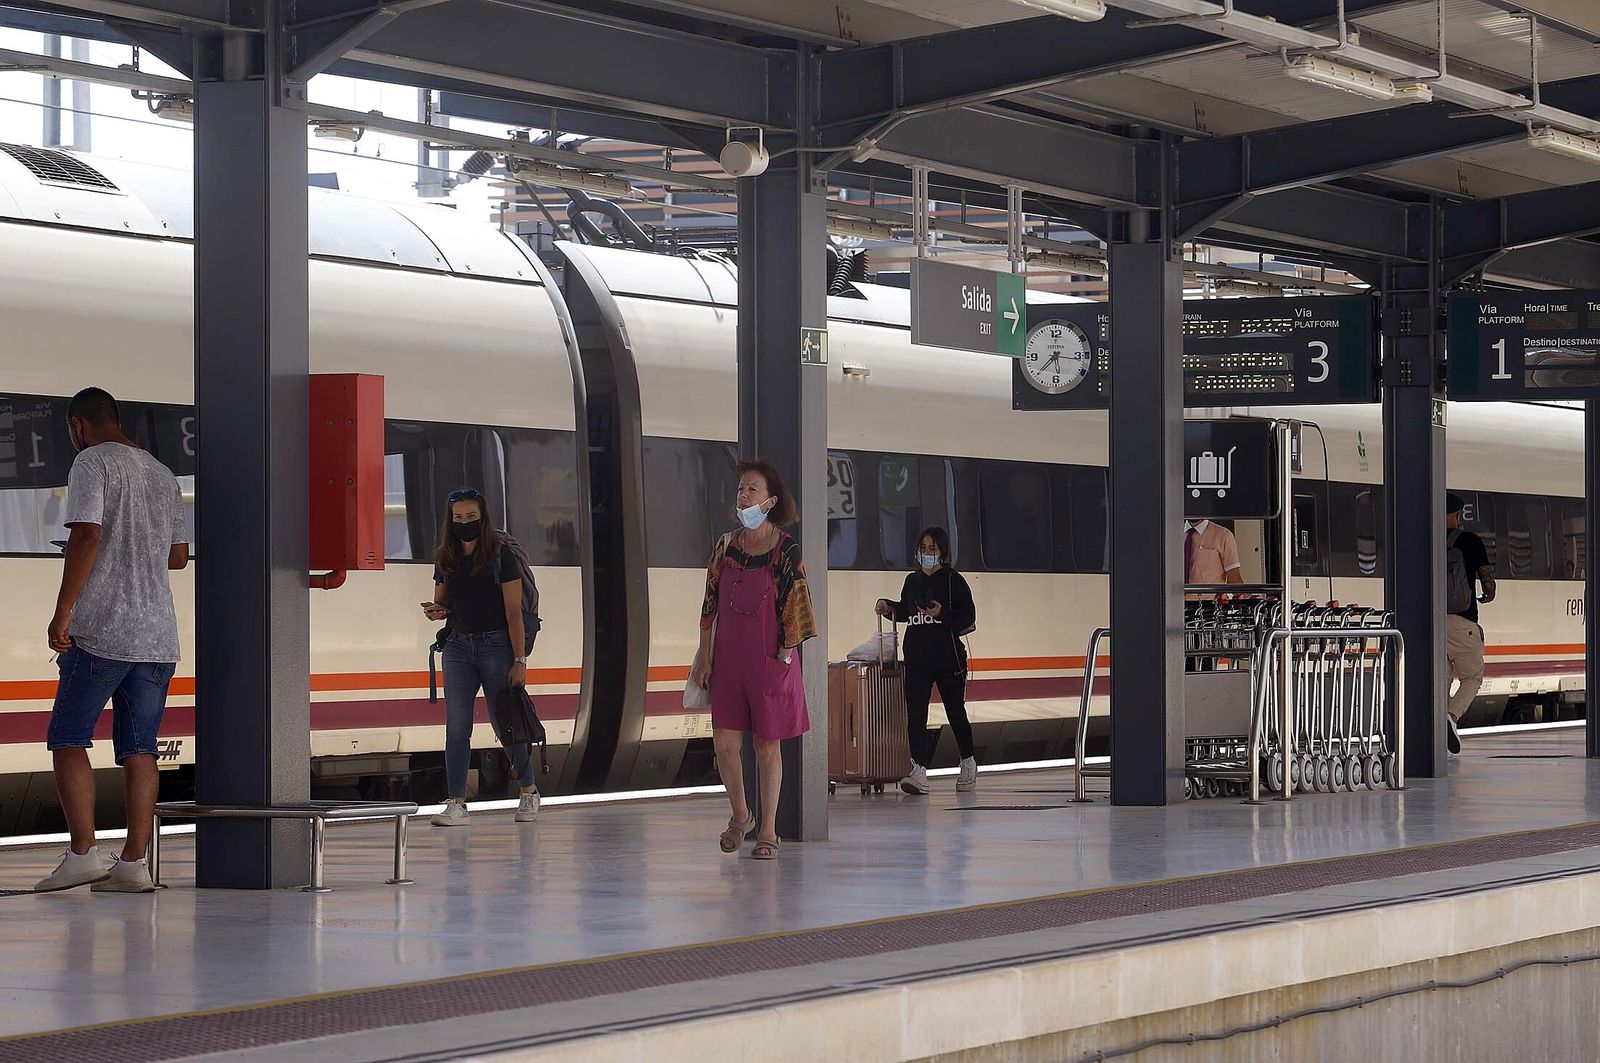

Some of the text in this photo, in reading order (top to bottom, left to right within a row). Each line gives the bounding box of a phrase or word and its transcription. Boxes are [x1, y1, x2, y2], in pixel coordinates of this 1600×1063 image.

[961, 284, 992, 313] Salida
[1294, 320, 1340, 329] PLATFORM
[1478, 316, 1525, 325] PLATFORM
[980, 322, 992, 335] EXIT
[1050, 329, 1063, 339] 12
[1030, 352, 1038, 362] 9
[1074, 351, 1082, 361] 3
[1491, 338, 1512, 380] 1
[1306, 340, 1331, 384] 3
[1052, 375, 1060, 384] 6
[1566, 599, 1586, 626] ren
